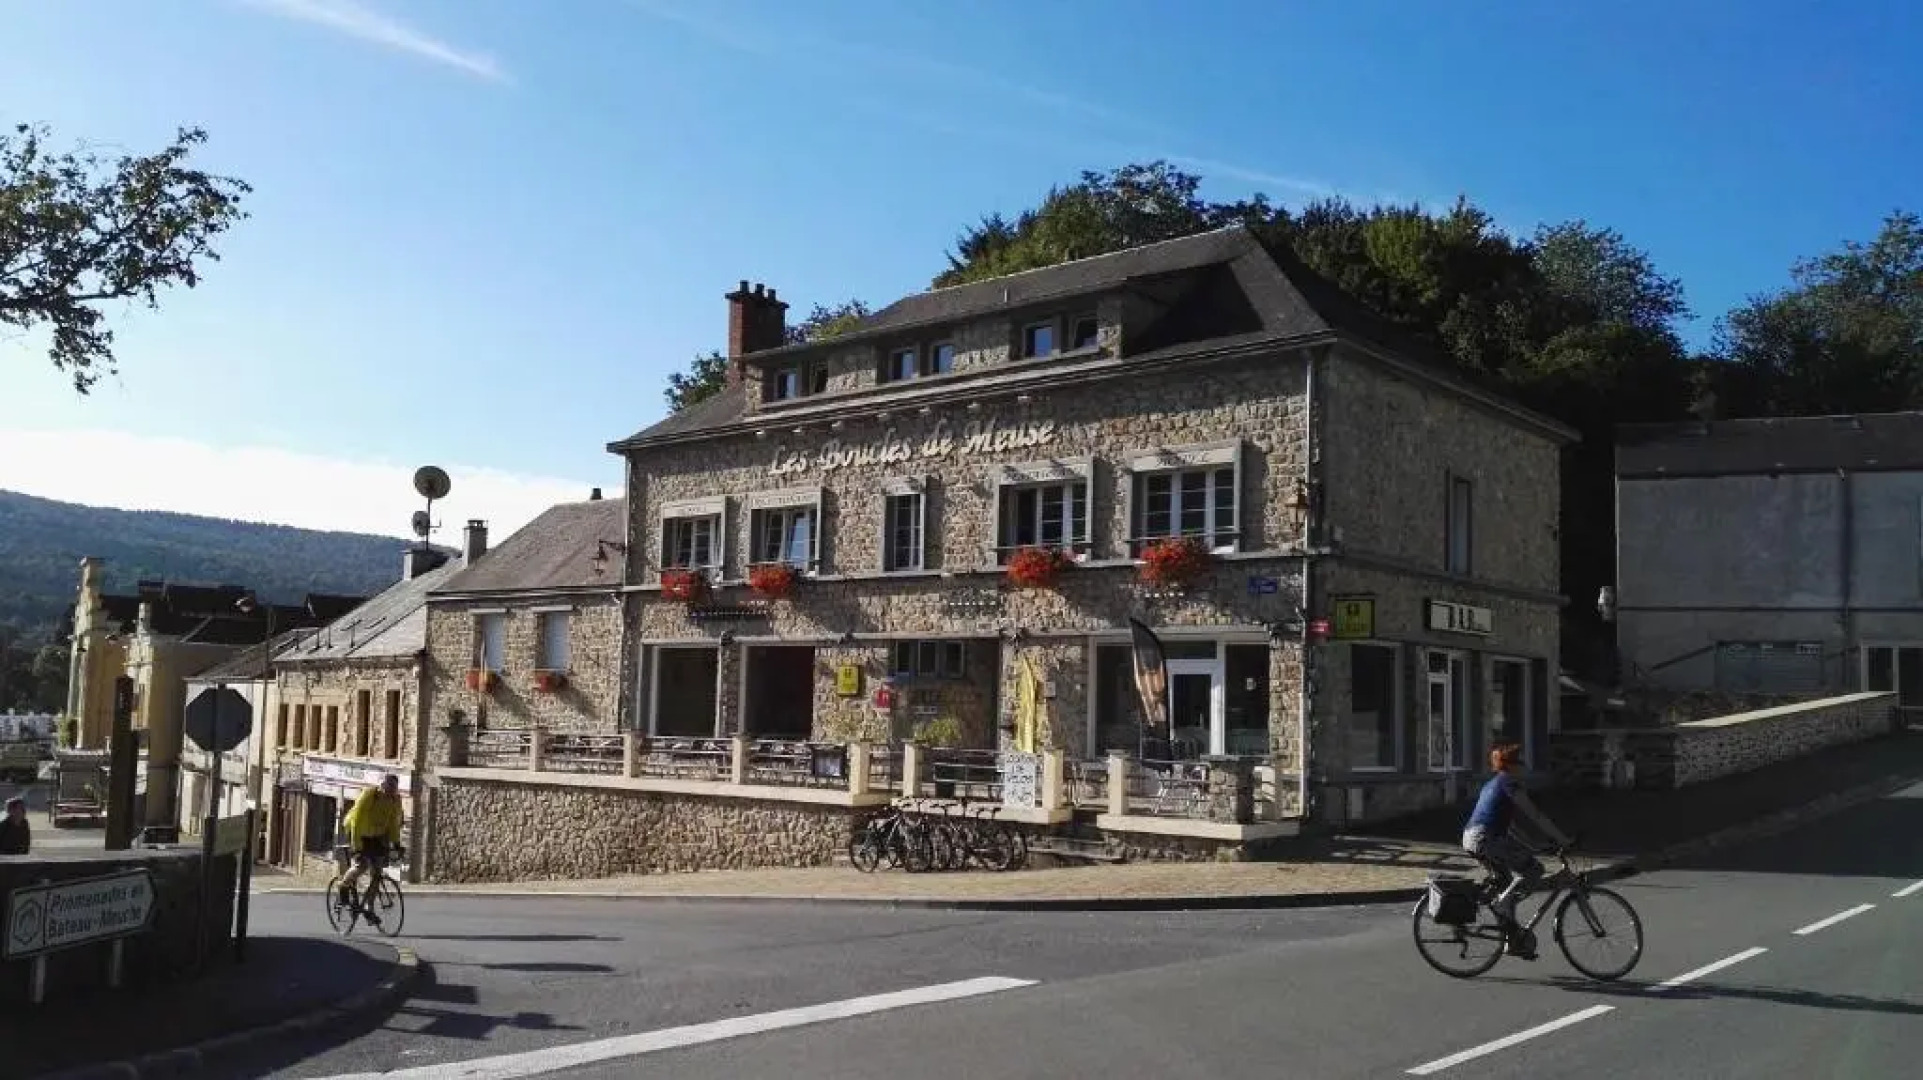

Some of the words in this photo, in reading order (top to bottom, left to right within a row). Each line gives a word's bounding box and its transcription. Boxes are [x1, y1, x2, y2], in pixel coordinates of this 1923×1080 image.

[768, 445, 807, 476] Les
[921, 418, 953, 457] de
[960, 419, 1058, 454] Meuse
